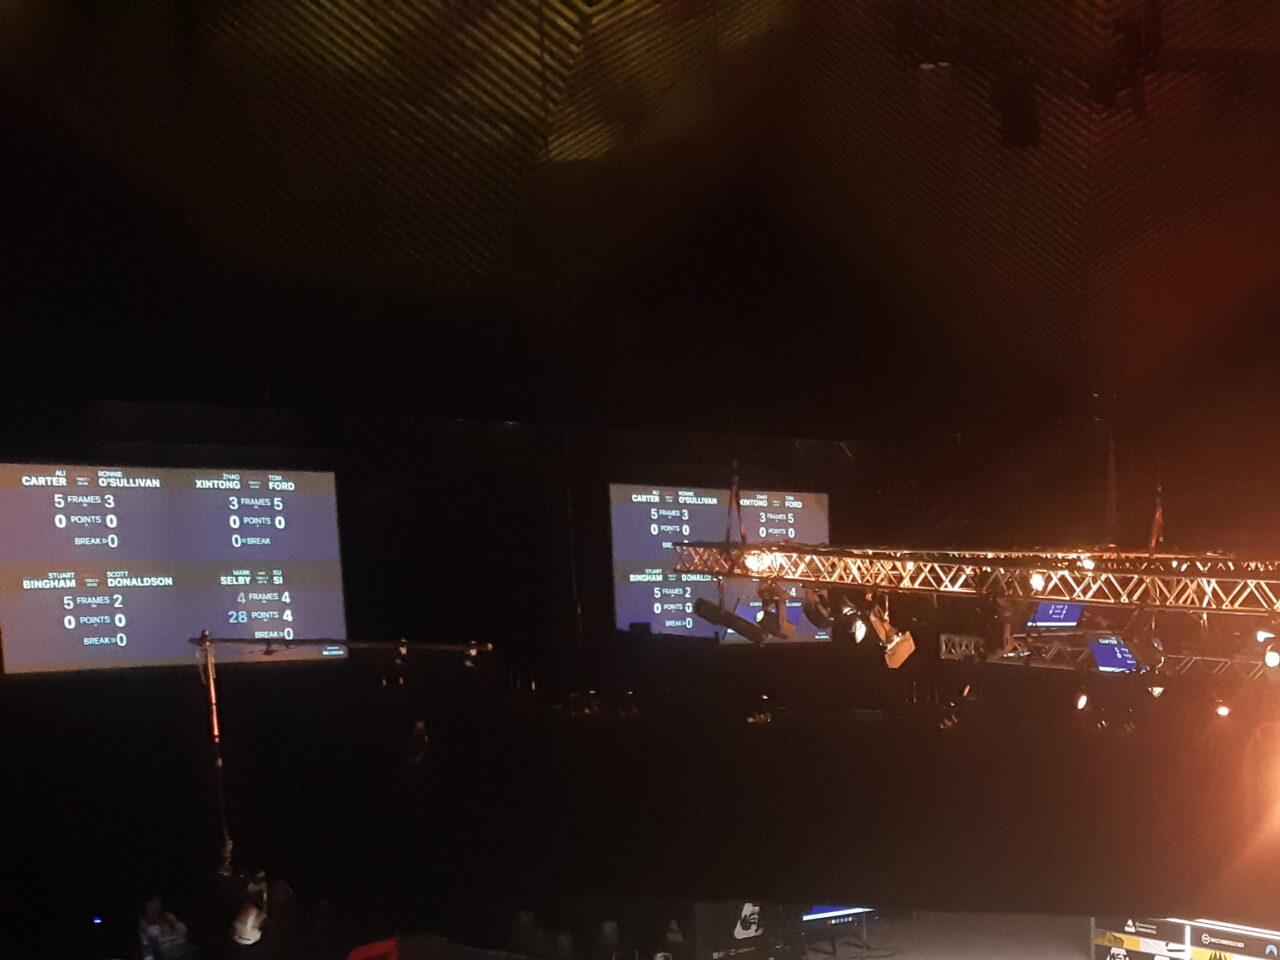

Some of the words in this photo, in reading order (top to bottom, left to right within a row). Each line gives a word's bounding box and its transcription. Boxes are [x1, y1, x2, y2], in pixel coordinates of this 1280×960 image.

[21, 476, 67, 486] CARTER
[98, 478, 161, 488] O'SULLIVAN
[195, 480, 241, 489] XINTONG
[268, 481, 295, 490] FORD
[54, 494, 65, 508] 5
[67, 495, 101, 503] FRAMES
[104, 494, 115, 508] 3
[229, 496, 239, 510] 3
[240, 498, 271, 506] FRAMES
[273, 498, 283, 511] 5
[631, 494, 660, 502] CARTER
[678, 496, 718, 504] O'SULLIVAN
[650, 508, 658, 519] 5
[682, 509, 689, 520] 3
[759, 512, 766, 523] 3
[788, 513, 794, 524] 5
[54, 514, 66, 528] 0
[106, 514, 117, 528] 0
[229, 515, 240, 529] 0
[243, 517, 271, 525] POINTS
[274, 516, 286, 529] 0
[650, 524, 658, 535] 0
[682, 524, 690, 536] 0
[759, 526, 767, 538] 0
[788, 528, 795, 539] 0
[74, 537, 102, 545] BREAK
[107, 534, 118, 548] 0
[231, 534, 242, 548] 0
[246, 537, 271, 545] BREAK
[22, 579, 76, 589] BINGHAM
[107, 577, 173, 587] DONALDSON
[220, 576, 251, 585] SELBY
[273, 576, 283, 585] SI
[629, 574, 663, 582] BINGHAM
[237, 592, 246, 604] 4
[248, 593, 279, 601] FRAMES
[281, 591, 291, 604] 4
[654, 587, 661, 598] 5
[684, 587, 691, 598] 2
[790, 587, 796, 597] 4
[63, 596, 74, 610] 5
[76, 596, 110, 605] FRAMES
[112, 594, 123, 608] 2
[653, 603, 661, 614] 0
[685, 602, 693, 613] 0
[63, 615, 76, 629] 0
[79, 616, 110, 624] POINTS
[114, 613, 126, 627] 0
[228, 611, 248, 623] 28
[251, 611, 279, 619] POINTS
[282, 609, 293, 622] 4
[685, 617, 693, 629] 0
[255, 631, 279, 639] BREAK
[284, 627, 294, 640] 0
[83, 637, 111, 646] BREAK
[116, 633, 127, 647] 0
